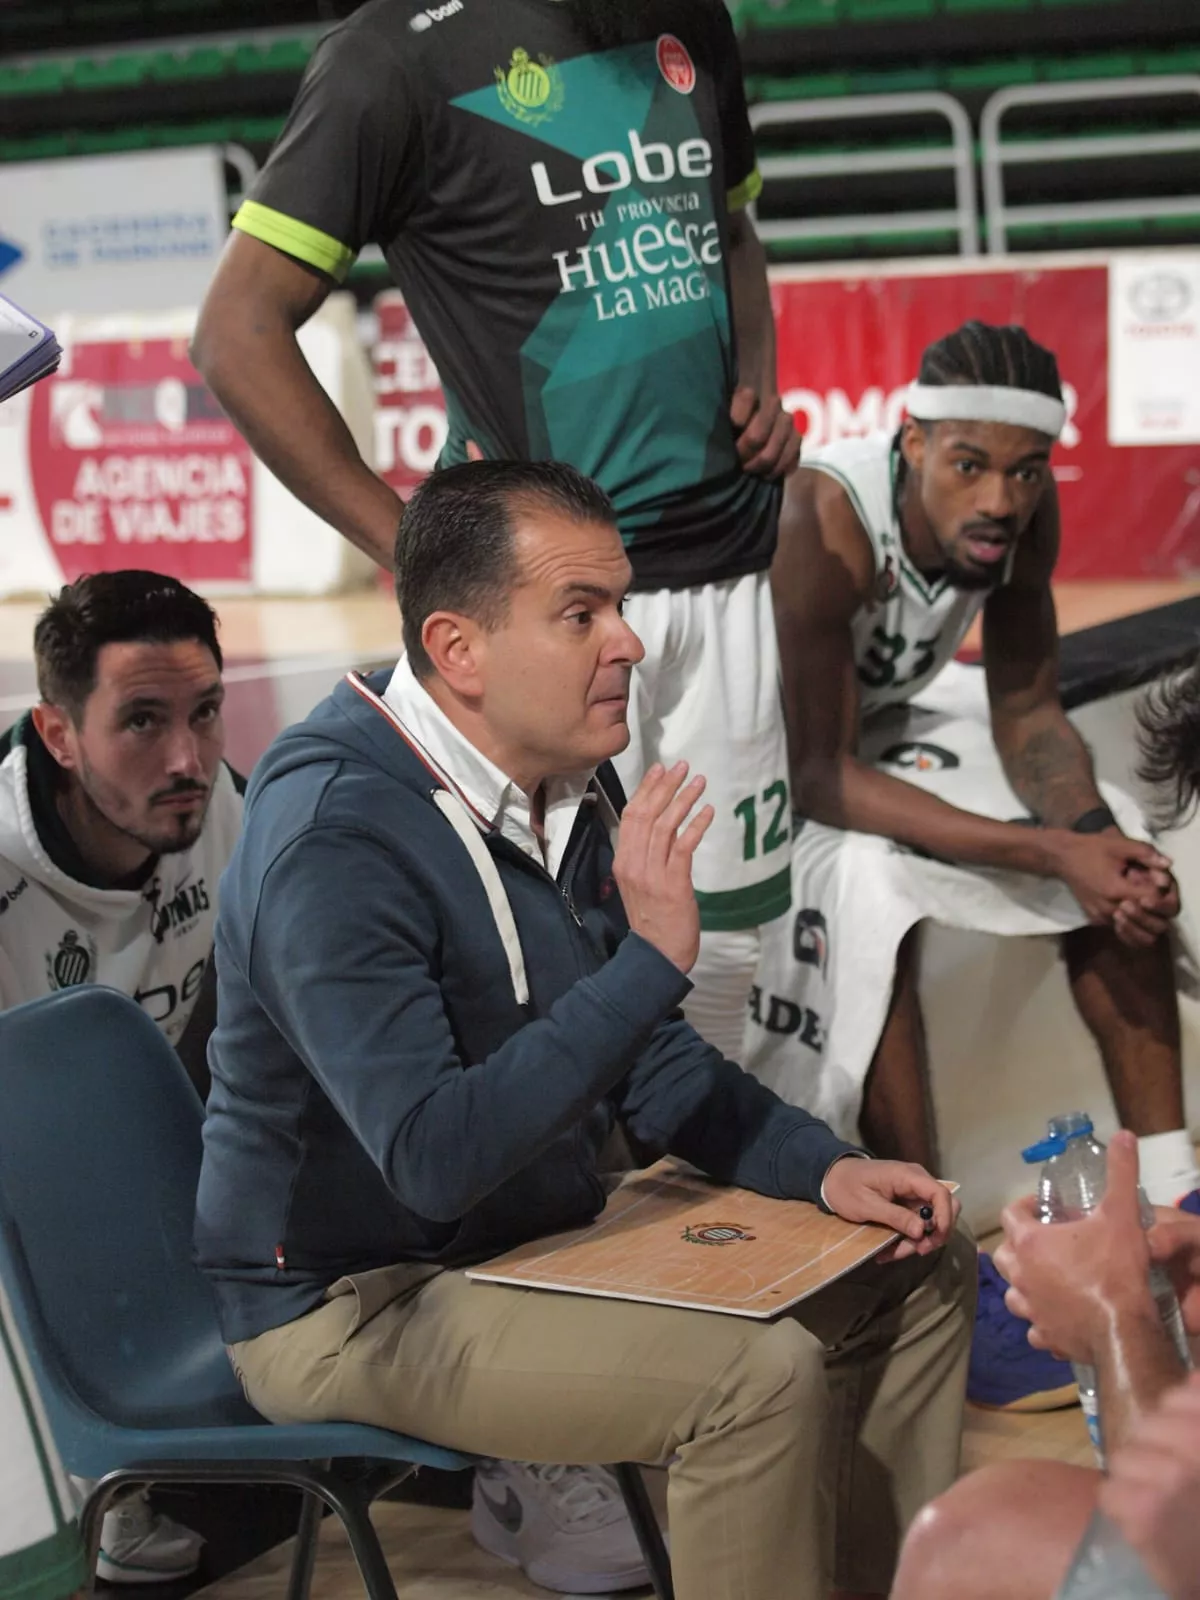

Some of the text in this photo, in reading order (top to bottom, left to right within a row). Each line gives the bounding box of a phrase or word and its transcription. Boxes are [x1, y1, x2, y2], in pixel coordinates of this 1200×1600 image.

[530, 128, 713, 206] Lobe
[73, 453, 247, 501] AGENCIA
[51, 498, 246, 545] DE VIAJES
[733, 779, 789, 862] 12
